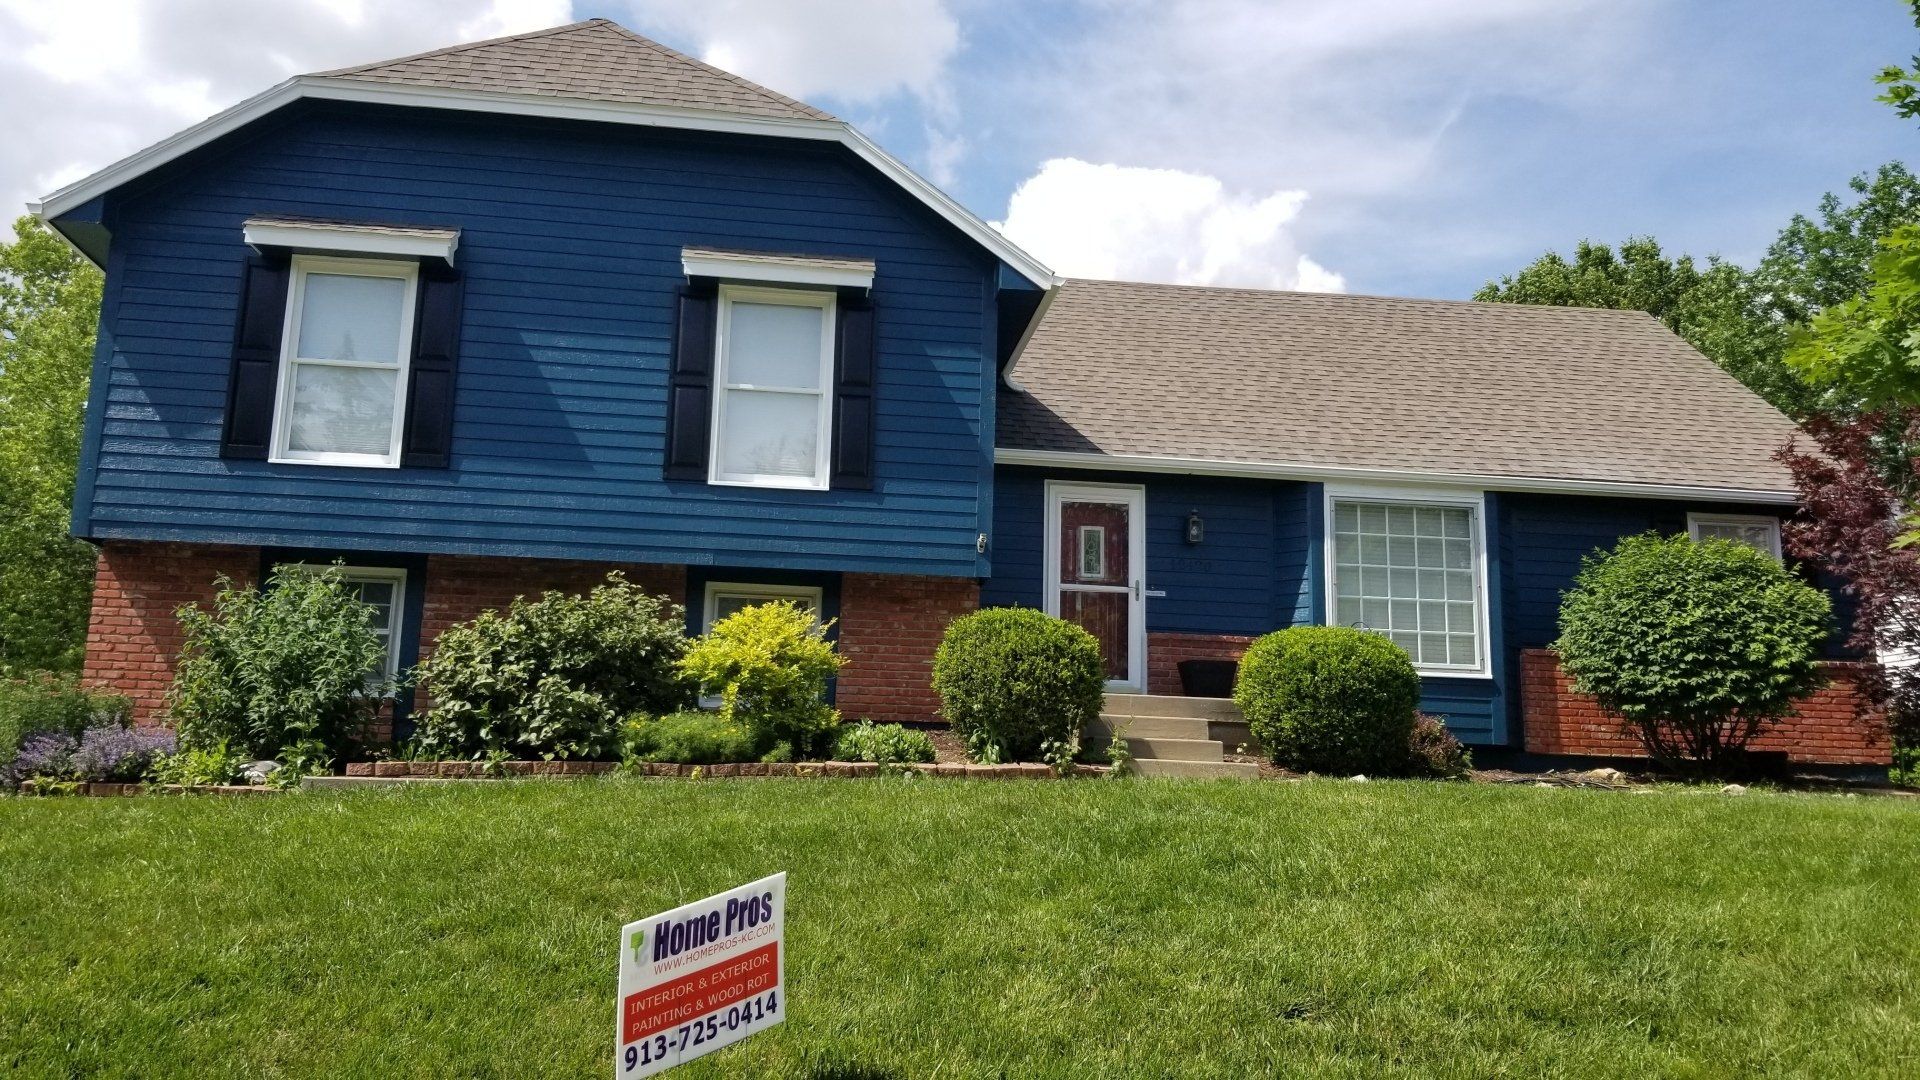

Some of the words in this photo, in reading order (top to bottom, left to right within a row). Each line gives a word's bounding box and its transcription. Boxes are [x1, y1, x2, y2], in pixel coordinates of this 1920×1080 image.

[653, 909, 720, 963] Home
[725, 891, 773, 937] Pros
[654, 922, 776, 975] WWW.HOMEPROS-KC.COM
[631, 982, 694, 1015] INTERIOR
[698, 977, 708, 989] &
[711, 953, 770, 985] EXTERIOR
[632, 1003, 692, 1035] PAINTING
[695, 999, 705, 1011] &
[707, 983, 744, 1006] WOOD
[747, 972, 770, 991] ROT
[624, 991, 778, 1073] 913-725-0414
